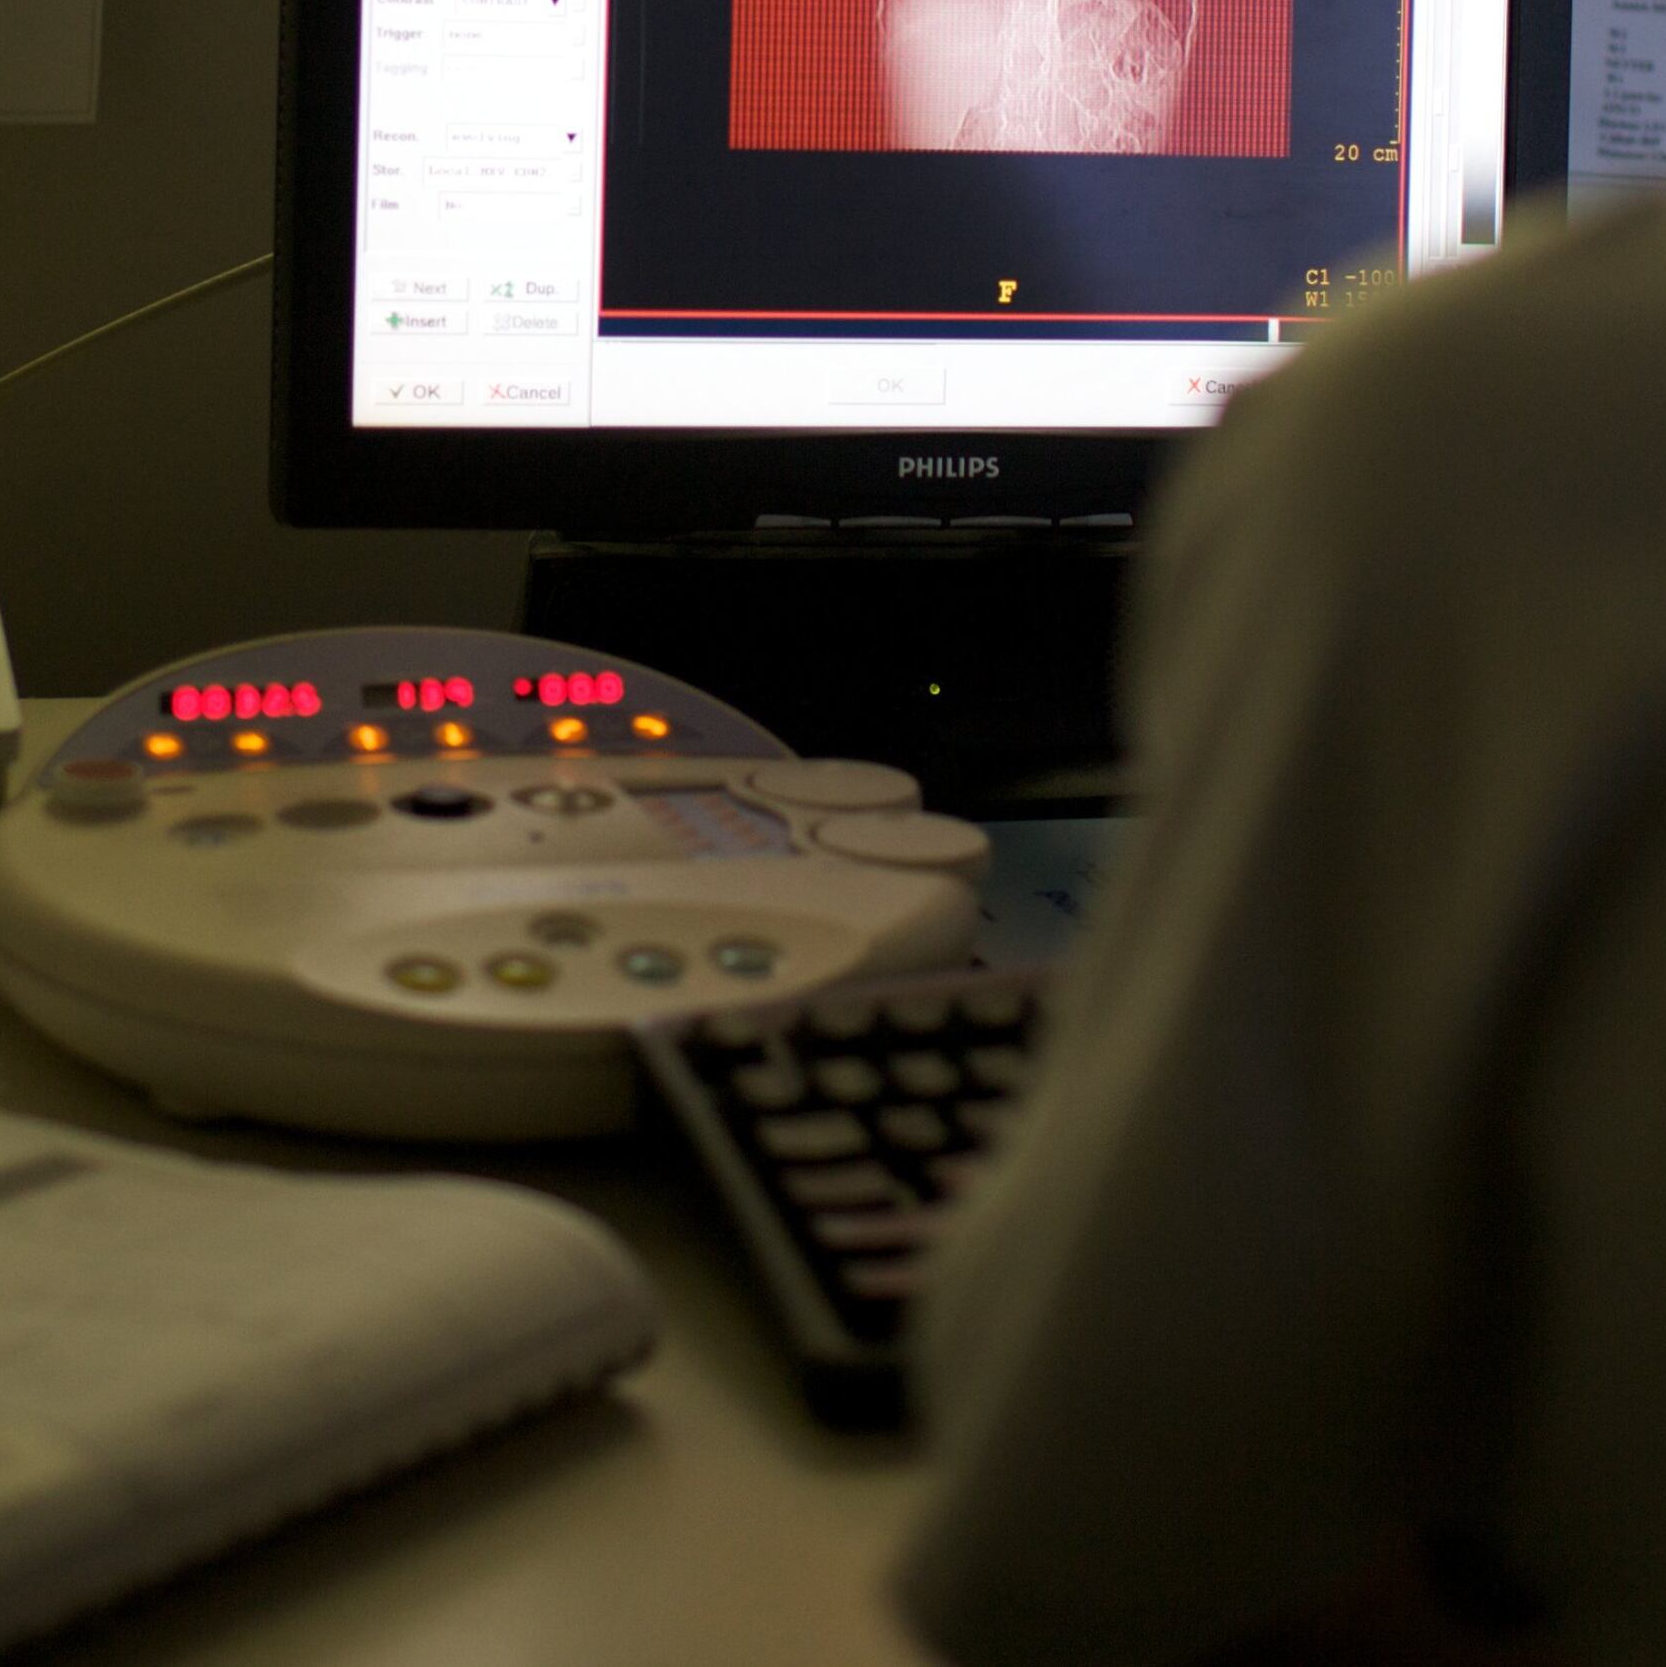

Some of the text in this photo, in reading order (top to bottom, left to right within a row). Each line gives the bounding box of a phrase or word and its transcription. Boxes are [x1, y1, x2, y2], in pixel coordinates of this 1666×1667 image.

[1334, 145, 1399, 163] 20 cm
[1305, 269, 1394, 286] C1 -100
[999, 281, 1016, 304] F
[1305, 290, 1330, 308] W1
[413, 385, 562, 400] OK Cancel
[876, 378, 904, 394] OK
[898, 456, 1000, 478] PHILIPS
